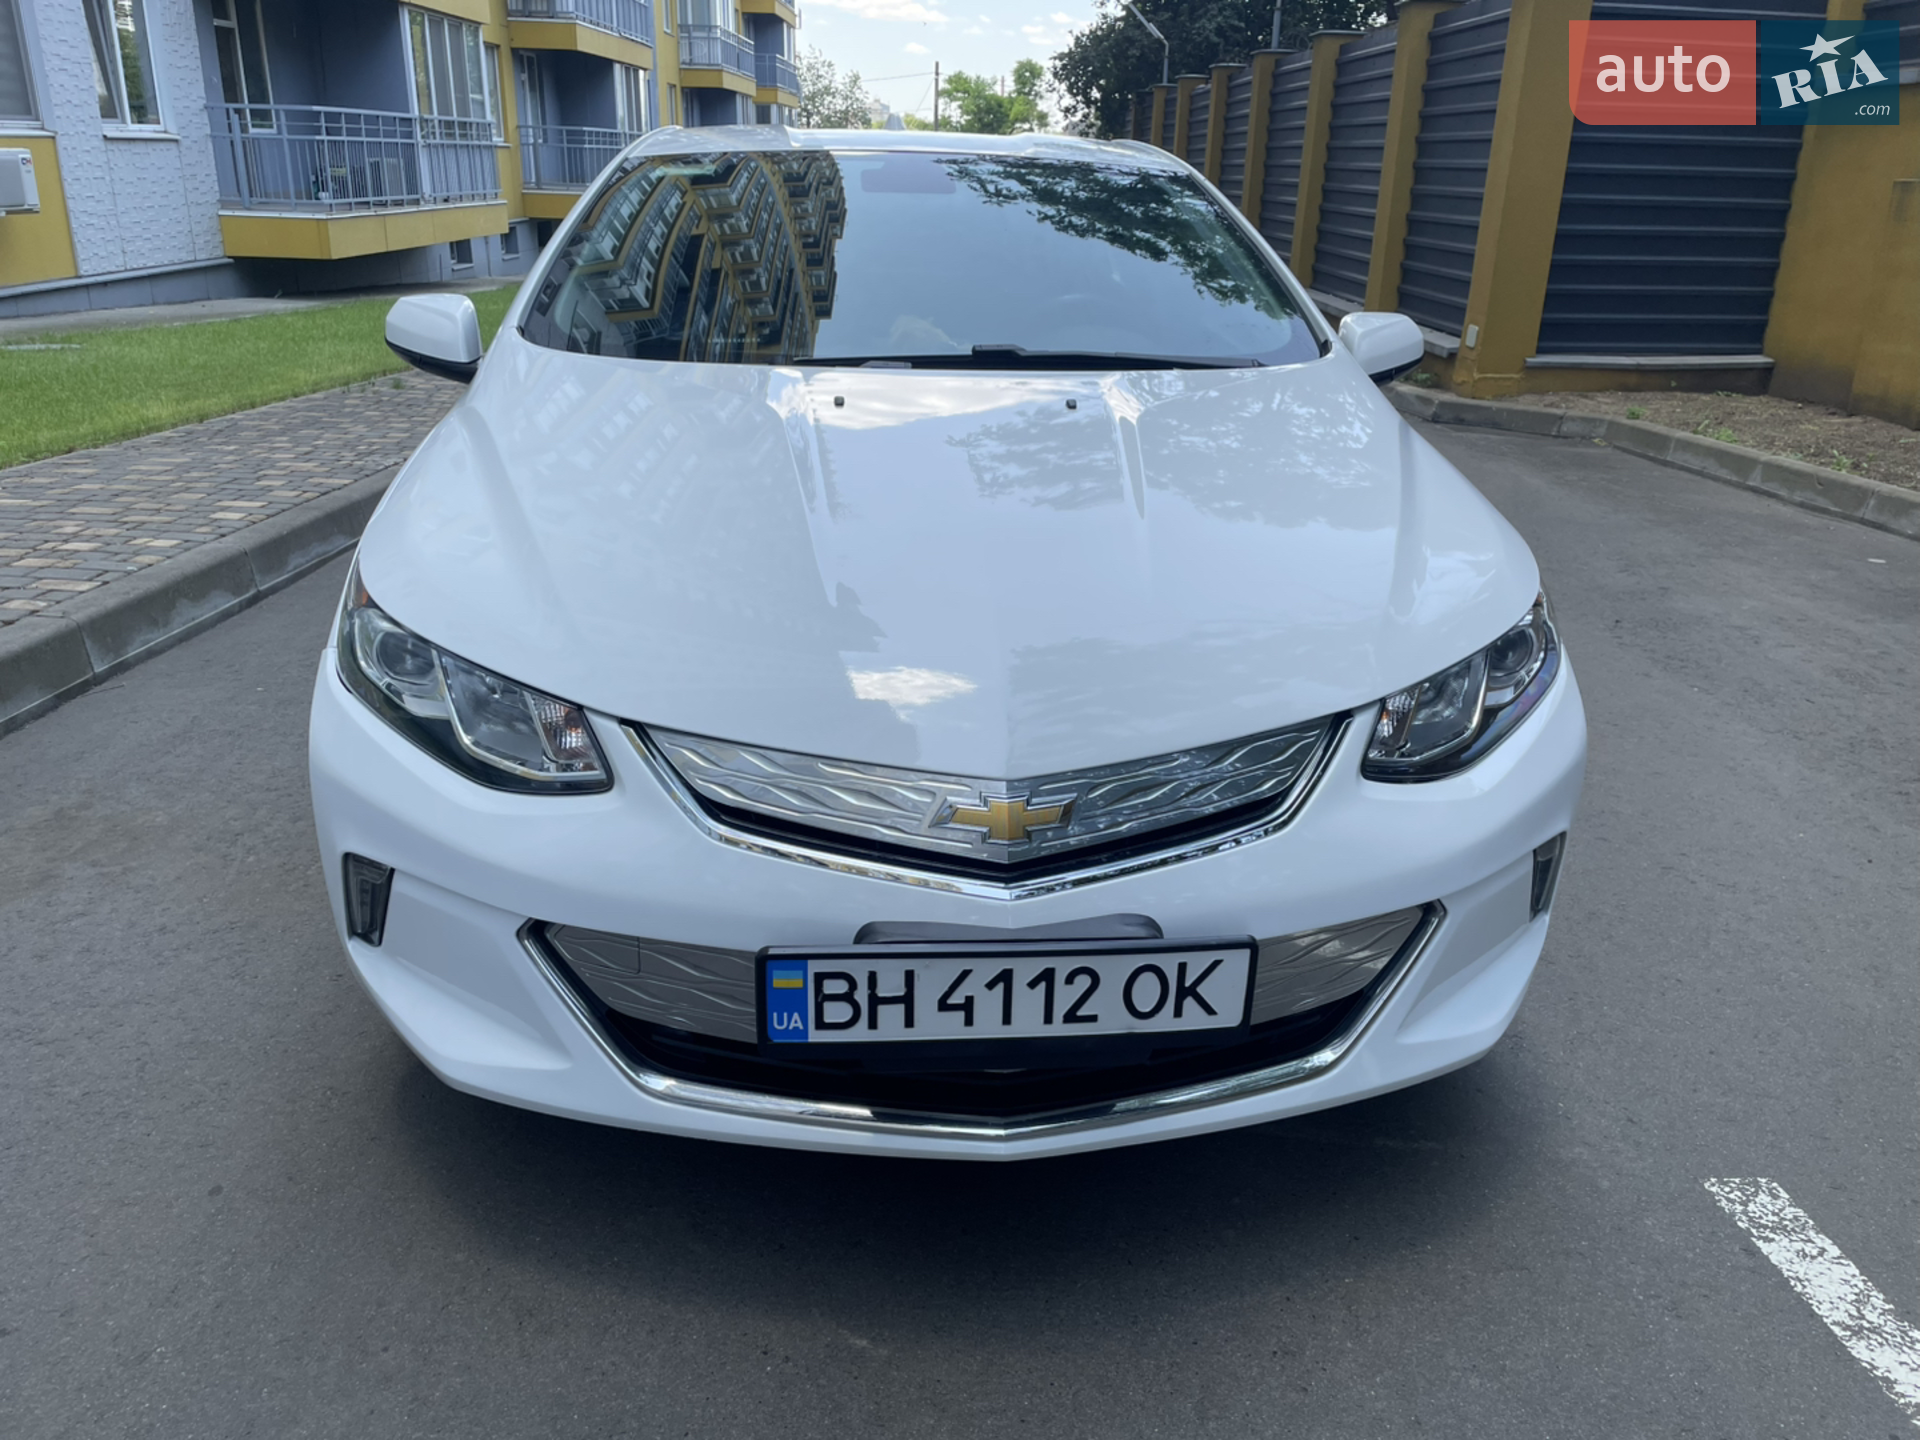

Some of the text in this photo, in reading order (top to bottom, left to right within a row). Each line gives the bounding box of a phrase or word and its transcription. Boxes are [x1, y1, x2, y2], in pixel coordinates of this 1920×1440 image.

[813, 958, 1225, 1031] BH 4112 OK
[772, 1011, 805, 1031] UA
